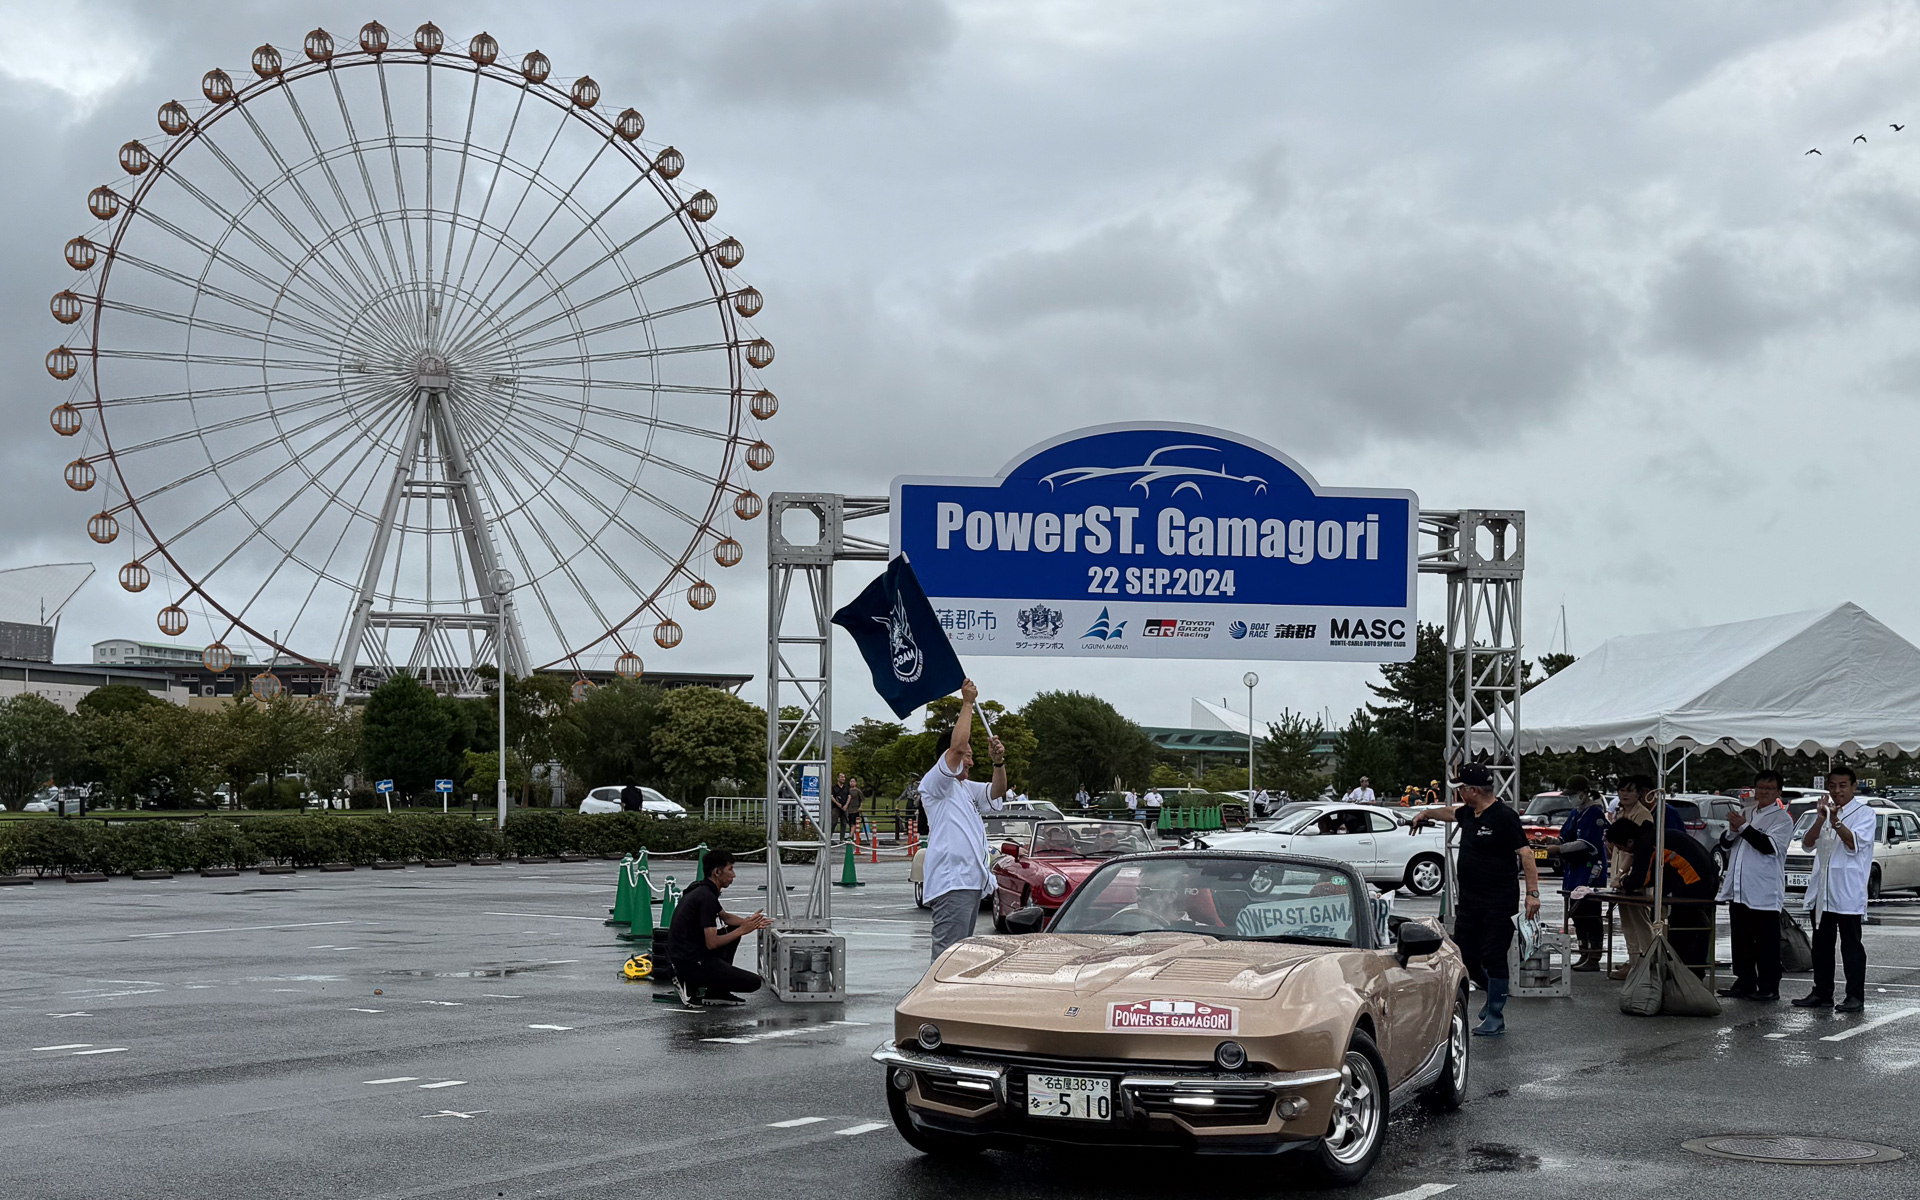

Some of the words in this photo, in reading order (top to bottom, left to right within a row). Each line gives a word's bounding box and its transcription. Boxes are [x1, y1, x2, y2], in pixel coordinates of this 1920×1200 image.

[936, 502, 1145, 554] PowerST.
[1157, 507, 1379, 565] Gamagori
[1088, 566, 1120, 594] 22
[1125, 567, 1236, 596] SEP.2024
[935, 608, 997, 630] 蒲郡市
[1179, 619, 1215, 627] TOYOTA
[1250, 623, 1270, 631] BOAT
[1249, 630, 1269, 638] RACE
[1274, 624, 1317, 639] 蒲郡
[1330, 618, 1406, 640] MASC
[1168, 1002, 1175, 1012] 1
[1115, 1009, 1154, 1027] POWER
[1155, 1015, 1170, 1027] ST.
[1171, 1013, 1229, 1029] GAMAGORI
